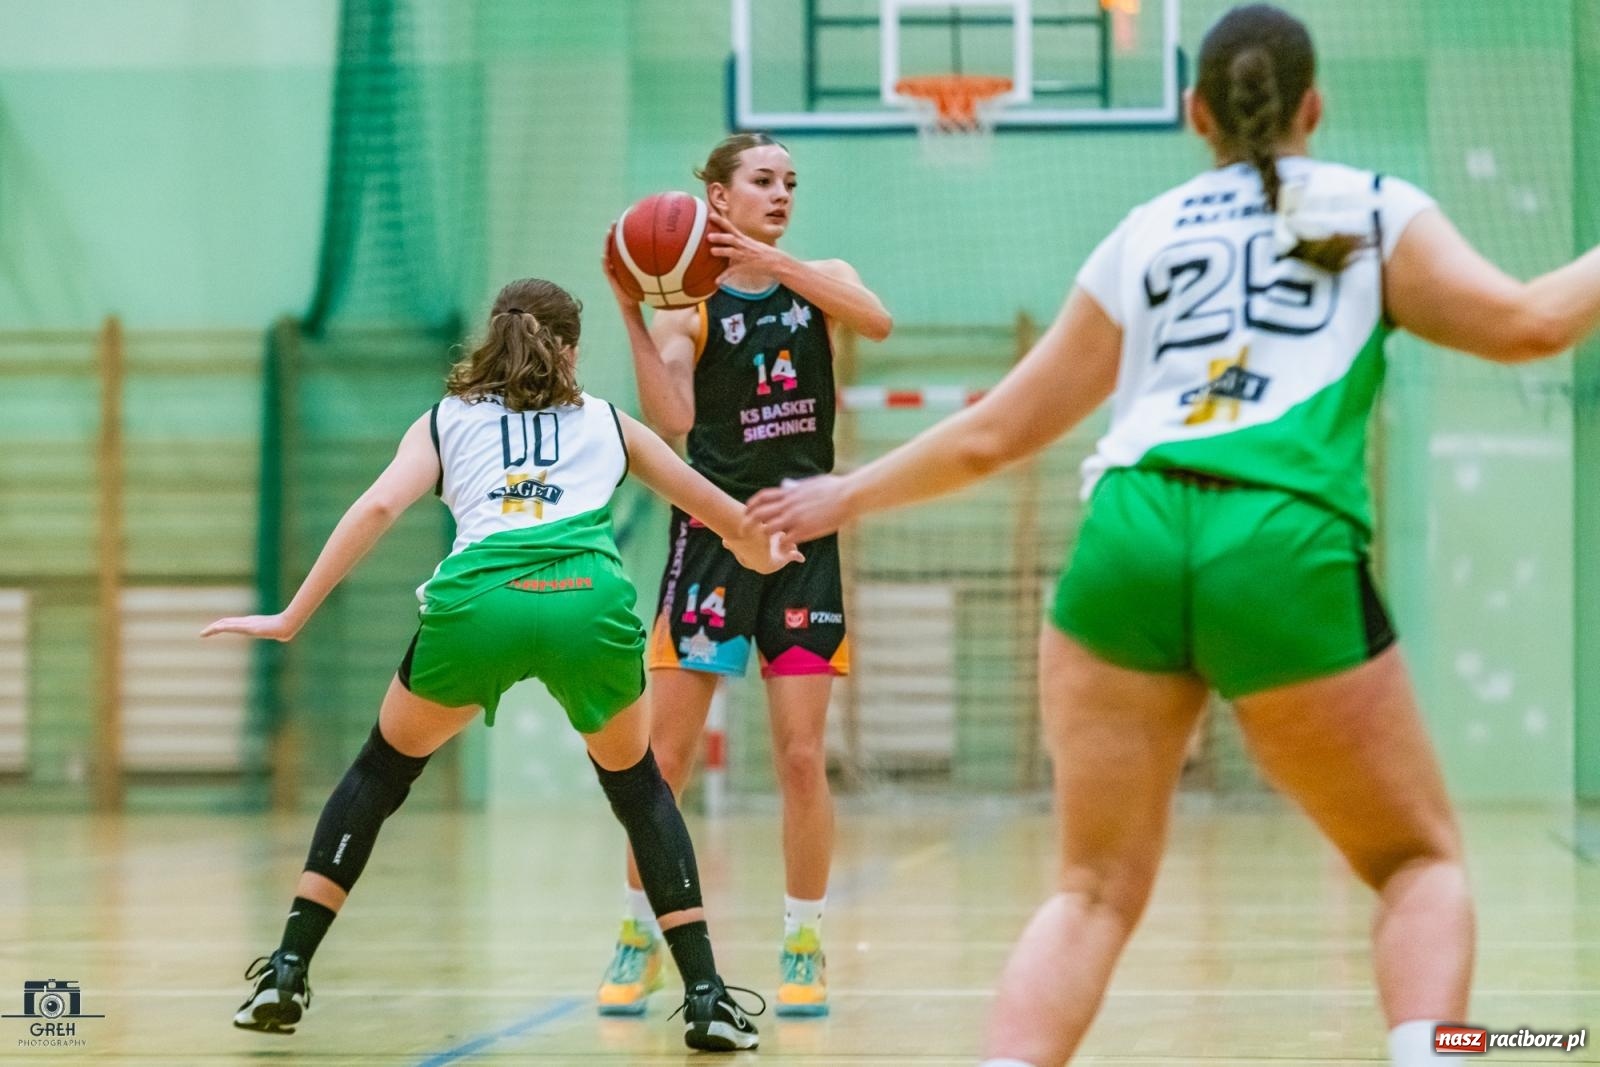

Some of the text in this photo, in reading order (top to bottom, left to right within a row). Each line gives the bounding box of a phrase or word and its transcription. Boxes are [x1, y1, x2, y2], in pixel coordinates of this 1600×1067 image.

[1144, 230, 1340, 364] 25
[753, 350, 798, 396] 14
[740, 399, 816, 424] KS BASKET
[743, 417, 816, 442] SIECHNICE
[501, 412, 559, 469] 00
[682, 583, 726, 628] 14
